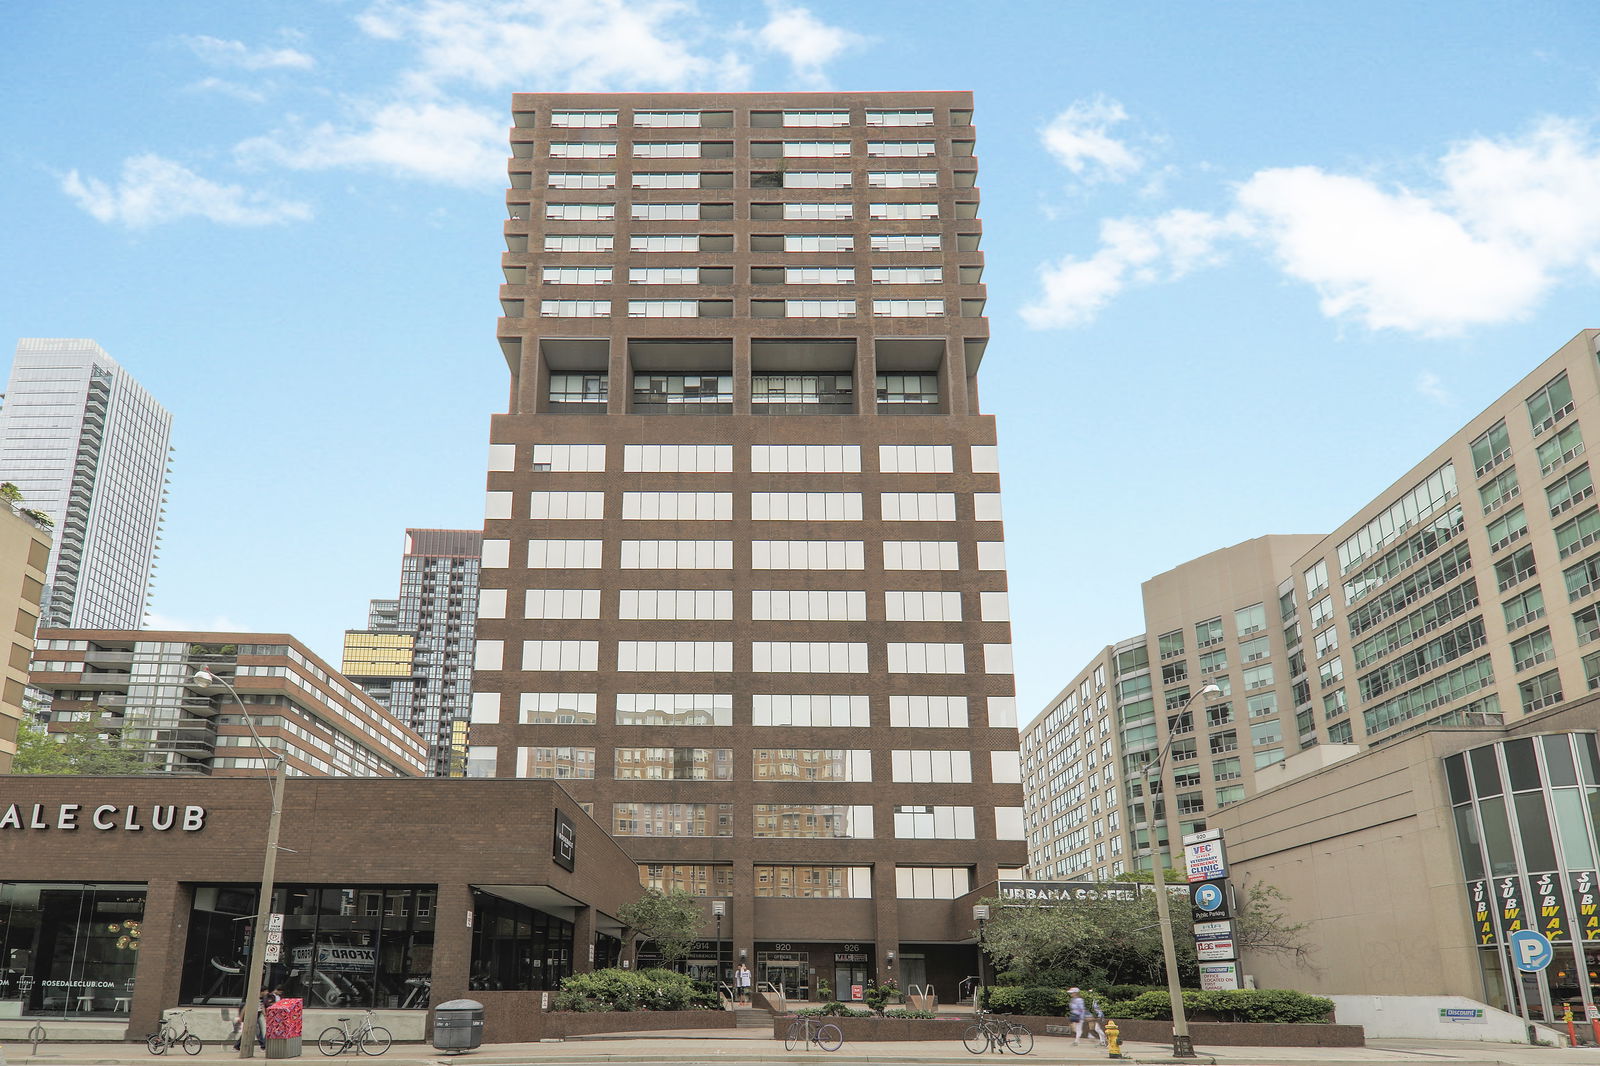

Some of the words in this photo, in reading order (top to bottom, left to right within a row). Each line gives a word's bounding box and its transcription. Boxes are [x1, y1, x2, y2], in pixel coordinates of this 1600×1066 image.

[0, 803, 80, 830] ALE
[93, 804, 206, 832] CLUB
[1193, 844, 1212, 855] VEC
[1190, 855, 1218, 864] VETERINARY
[1191, 864, 1219, 874] CLINIC
[1500, 877, 1521, 931] SUBWA
[1537, 873, 1564, 941] SUBWAY
[1209, 910, 1226, 918] Parking
[1473, 881, 1494, 944] SUBWAY
[775, 943, 791, 951] 920
[844, 944, 860, 952] 926
[41, 980, 115, 988] ROSEDALECLUB.COM
[1446, 1009, 1475, 1017] Discount
